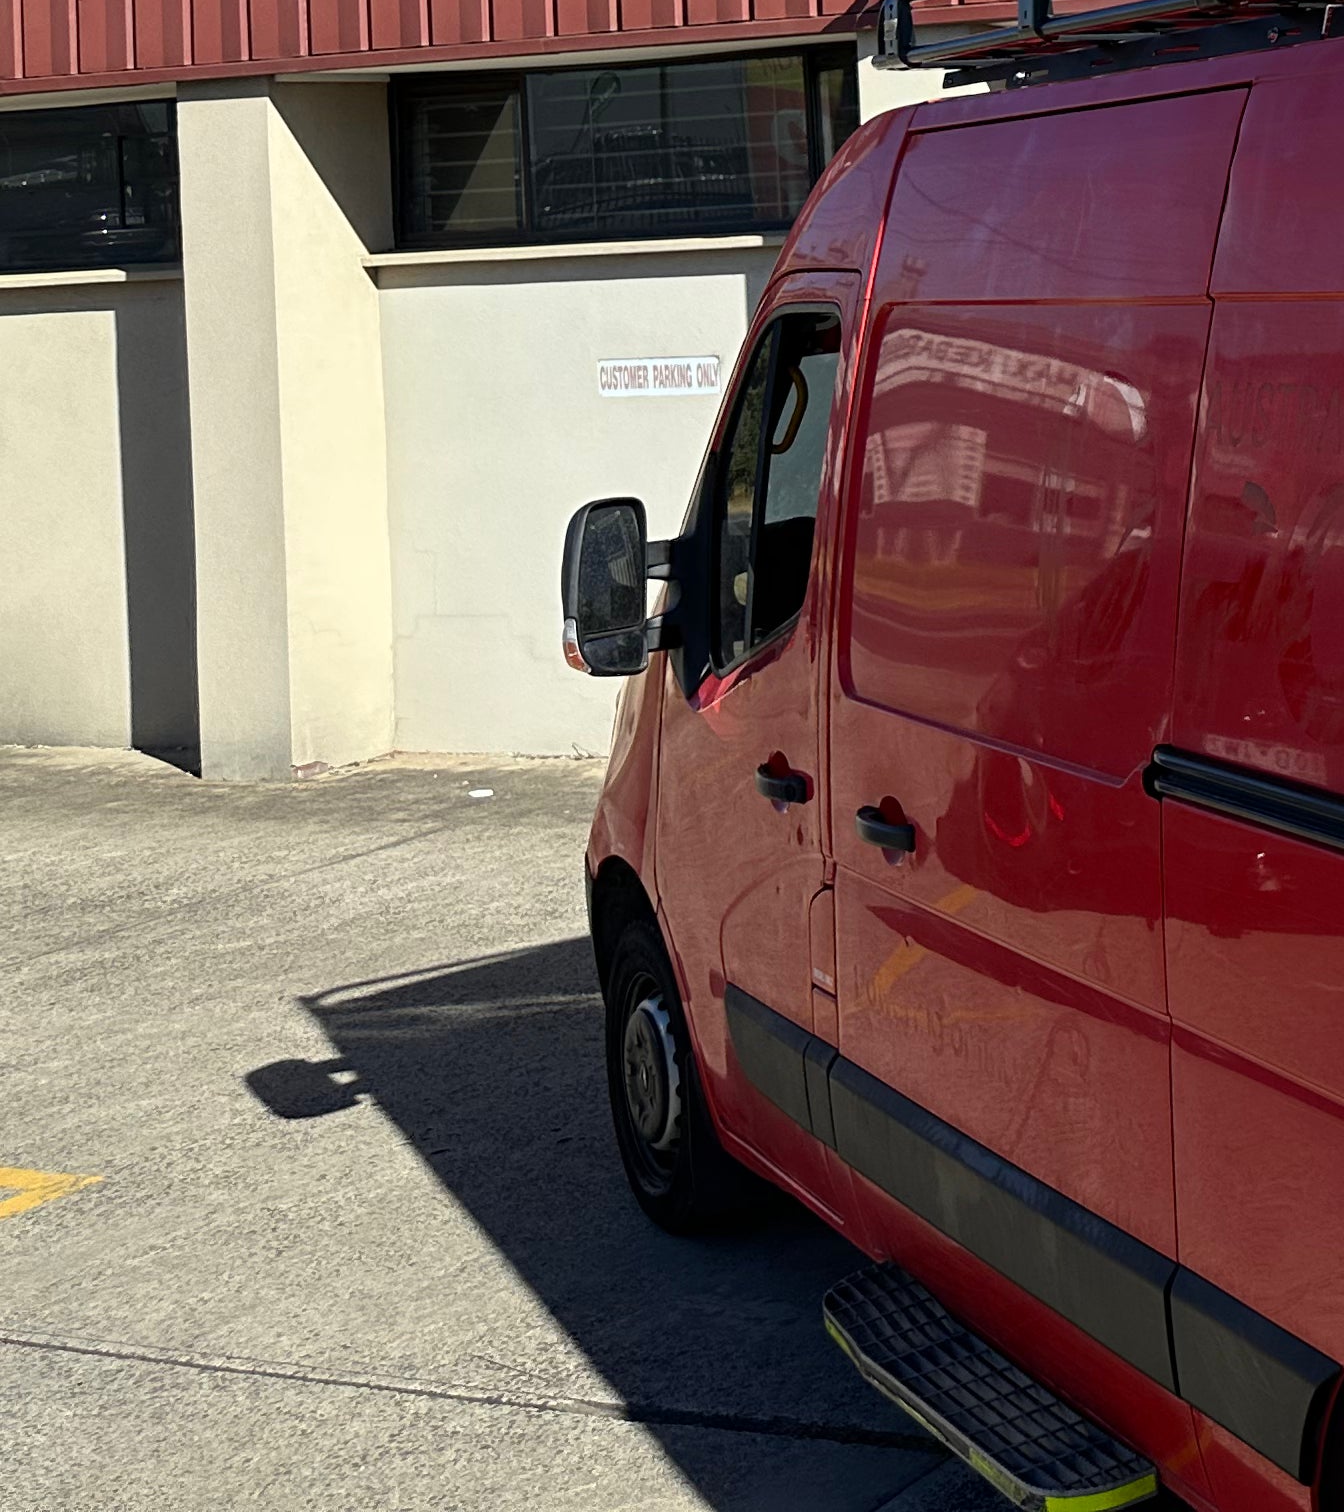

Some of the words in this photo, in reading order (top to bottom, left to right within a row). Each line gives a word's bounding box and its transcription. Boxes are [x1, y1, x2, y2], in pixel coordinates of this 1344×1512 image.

[600, 365, 649, 390] CUSTOMER
[652, 363, 692, 388] PARKING
[696, 362, 719, 387] ONLY
